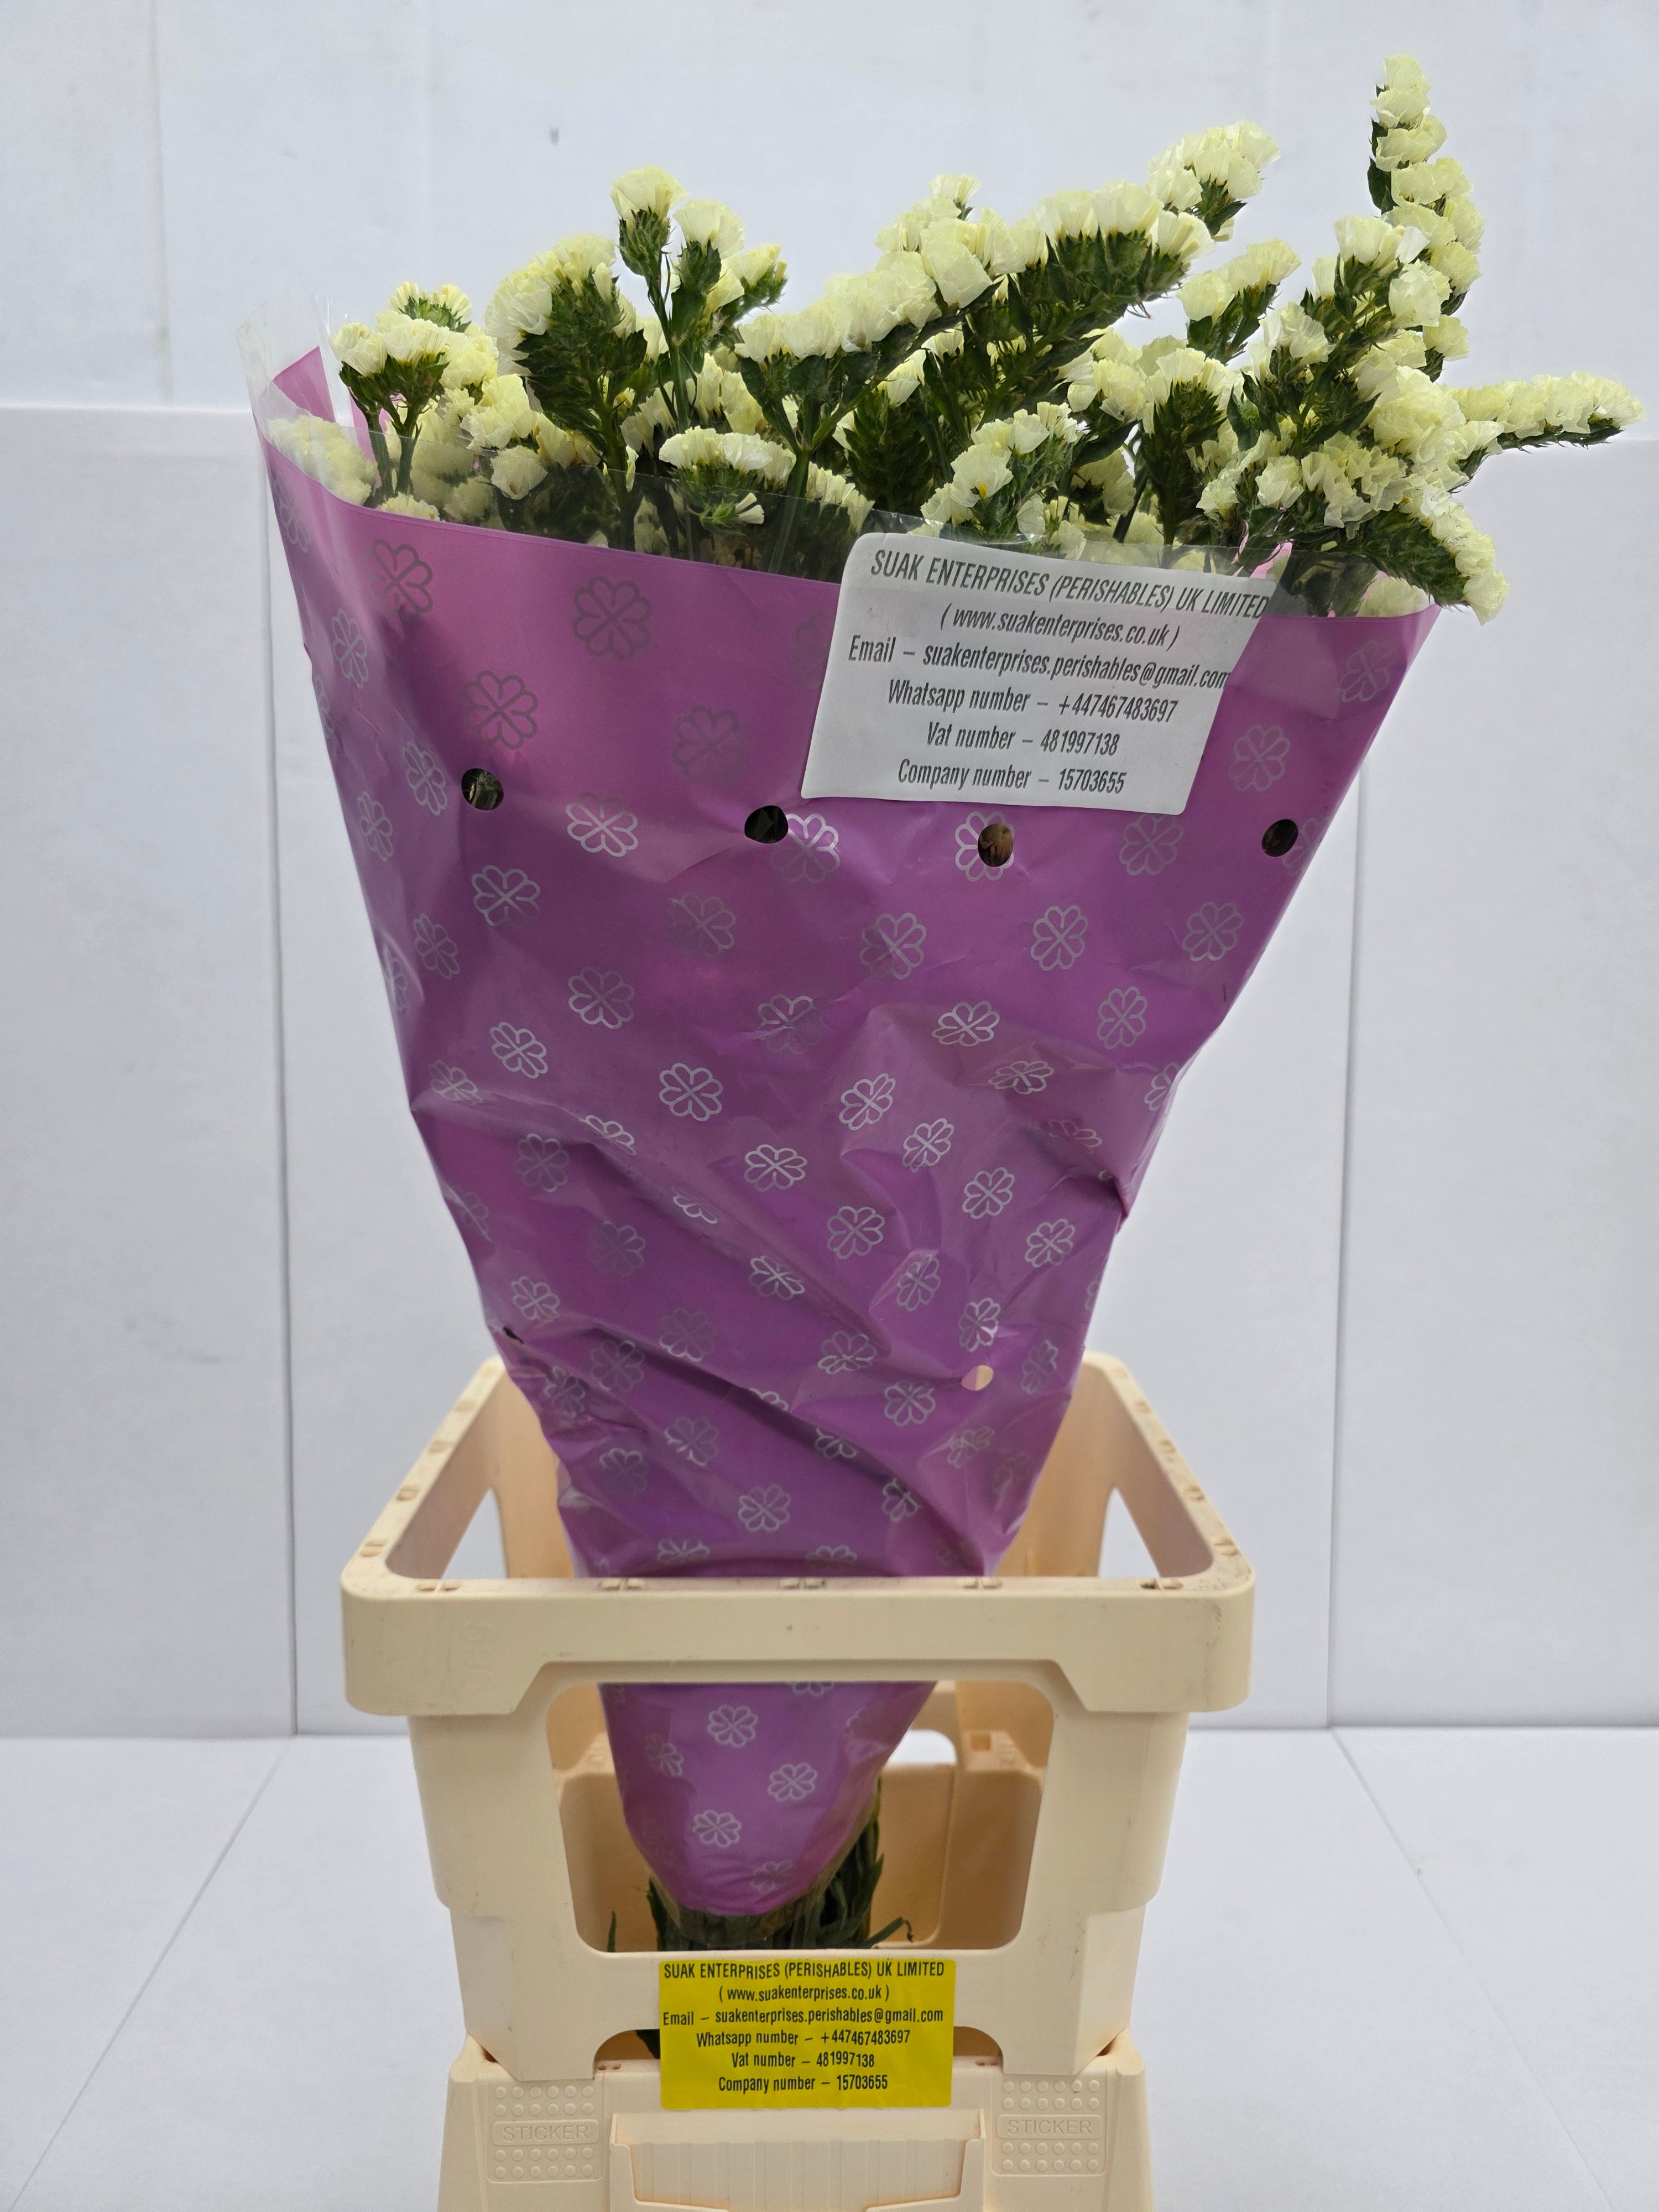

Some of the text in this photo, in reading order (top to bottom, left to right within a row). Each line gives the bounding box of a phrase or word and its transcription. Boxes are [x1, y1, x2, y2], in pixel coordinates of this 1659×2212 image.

[871, 550, 1270, 619] SUAK ENTERPRISES (PERISHABLES) UK LIMITED
[953, 609, 1170, 646] www.suakenterprises.co.uk
[848, 635, 896, 662] Email
[888, 679, 966, 713] Whatsapp
[969, 687, 1031, 712] number
[1058, 693, 1178, 722] +447467483697
[927, 721, 952, 747] Vat
[955, 726, 1016, 749] number
[1040, 729, 1120, 756] 481997138
[898, 759, 970, 790] Company
[972, 765, 1032, 789] number
[1058, 768, 1127, 794] 15703655
[664, 1961, 944, 1979] SUAK ENTERPRISES (PERISHABLES) UK LIMITED
[727, 1985, 881, 2001] www.suakenterprises.co.uk
[664, 2011, 693, 2025] Email
[716, 2007, 943, 2025] suakenterprises.perishables@gmail.com
[697, 2032, 751, 2047] Whatsapp
[757, 2030, 798, 2045] number
[821, 2030, 910, 2045] +447467483697
[732, 2052, 748, 2068] Vat
[754, 2052, 795, 2067] number
[816, 2051, 874, 2067] 481997138
[719, 2077, 769, 2094] Company
[774, 2076, 815, 2090] number
[837, 2074, 888, 2090] 15703655
[503, 2125, 589, 2141] STICKER
[1007, 2120, 1092, 2135] STICKER
